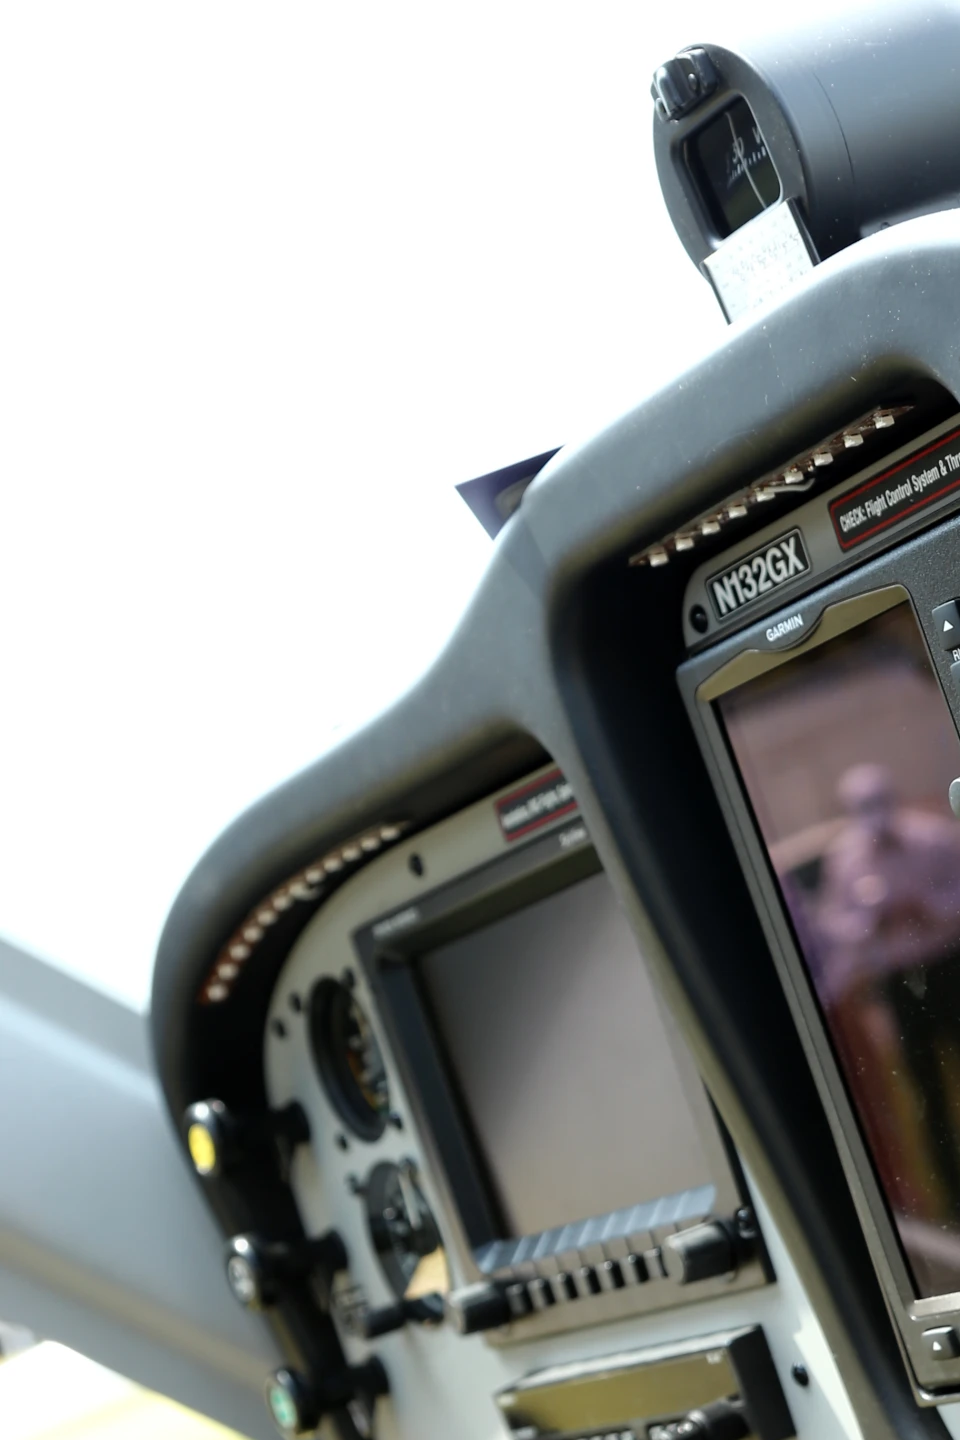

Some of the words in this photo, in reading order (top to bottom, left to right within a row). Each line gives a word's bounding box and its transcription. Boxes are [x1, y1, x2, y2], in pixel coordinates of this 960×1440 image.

[839, 509, 867, 533] CHECK:
[864, 494, 888, 518] Flight
[885, 478, 913, 506] Control
[911, 466, 940, 493] System
[938, 460, 948, 476] &
[712, 538, 806, 616] N132GX
[765, 614, 804, 642] GARMIN
